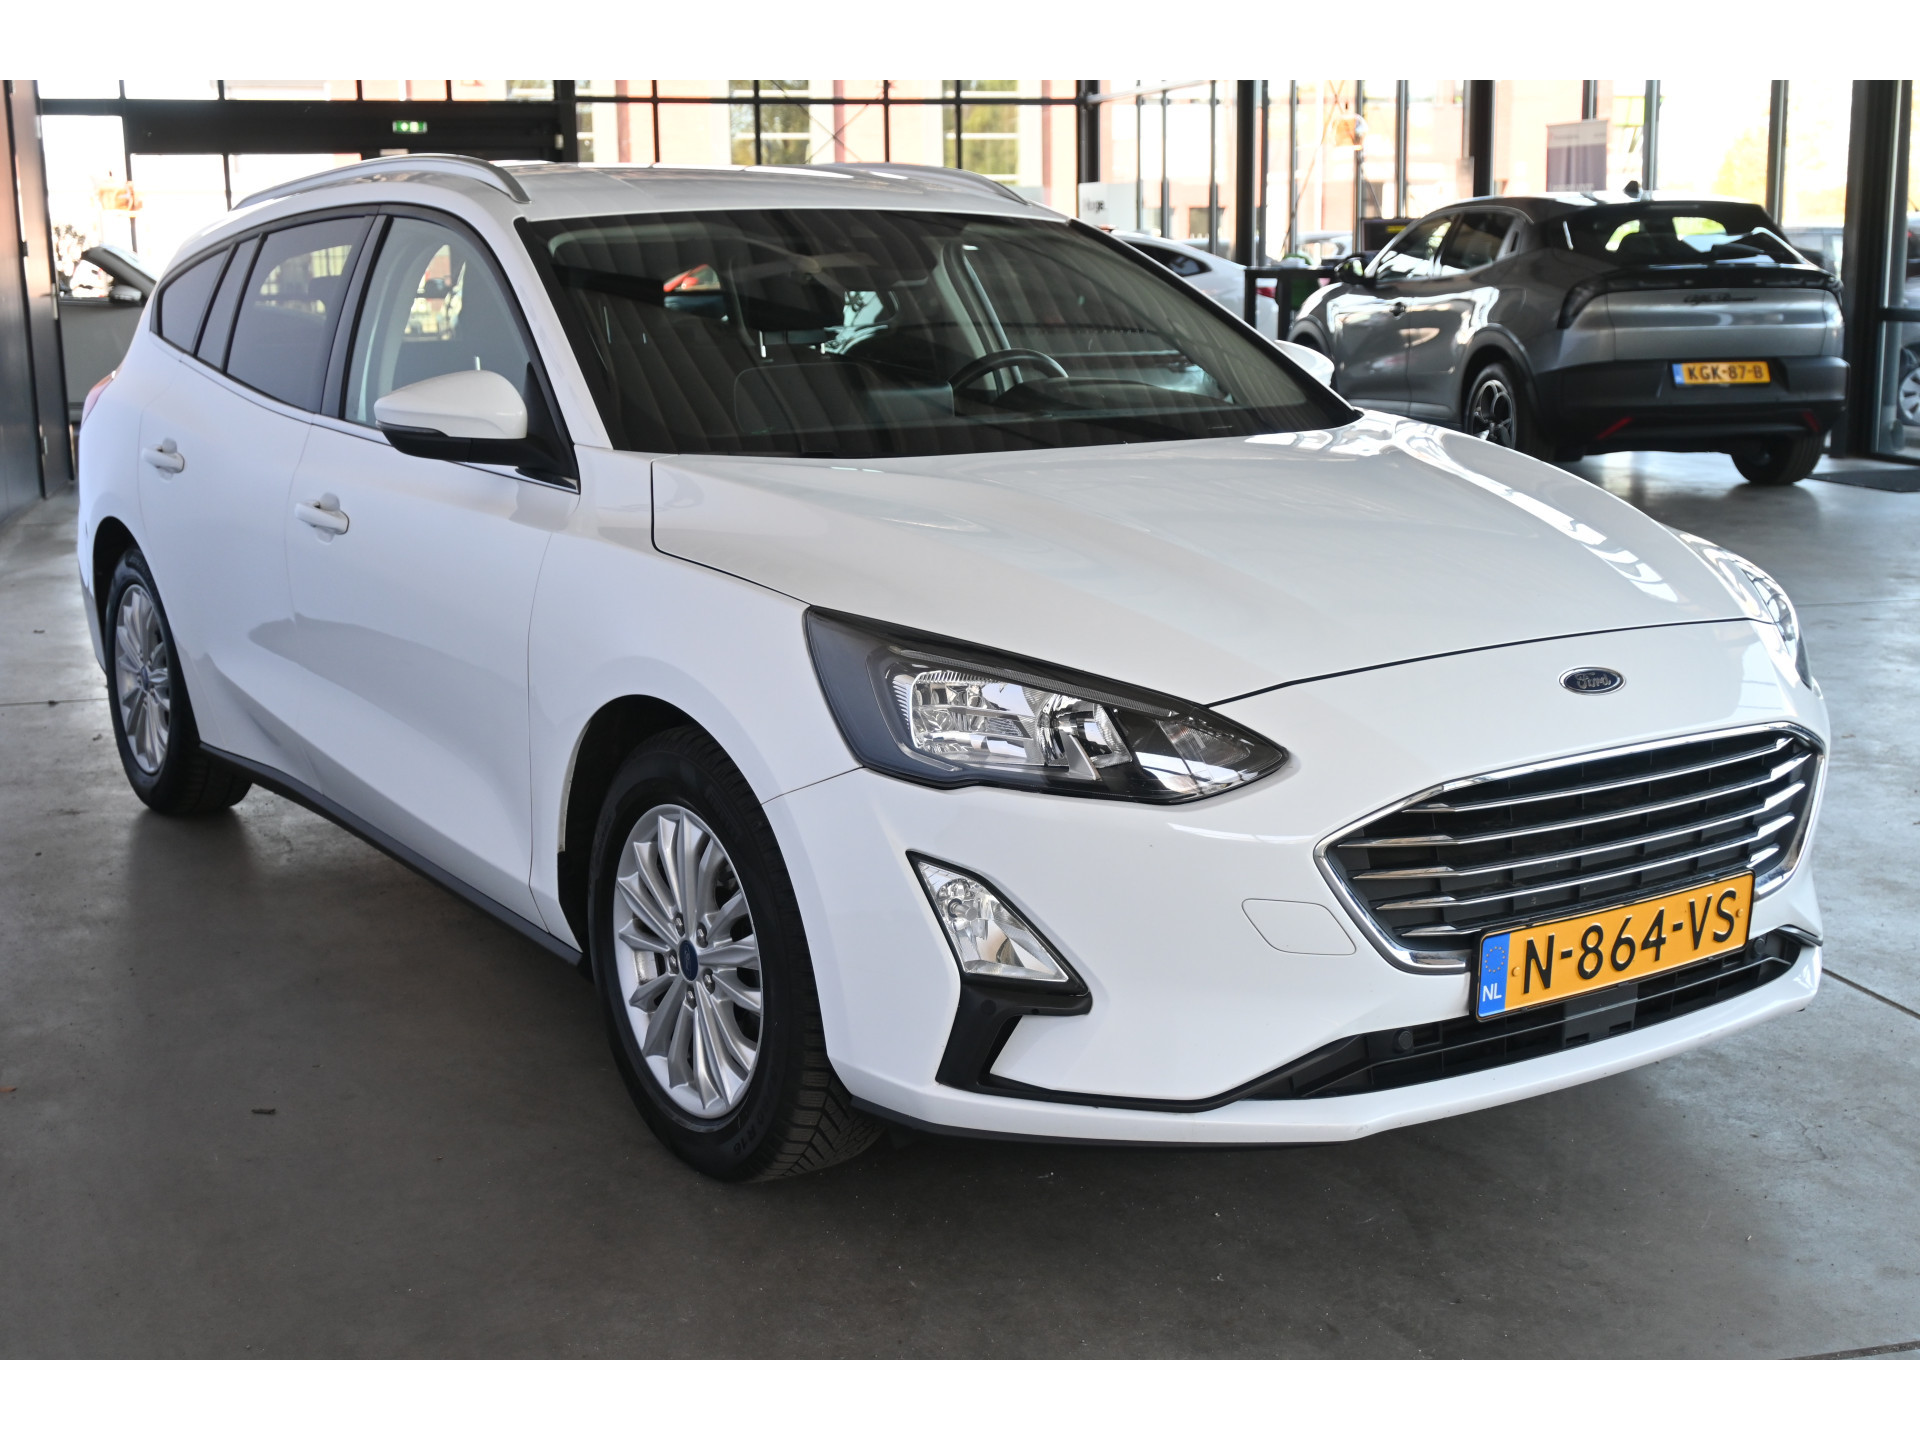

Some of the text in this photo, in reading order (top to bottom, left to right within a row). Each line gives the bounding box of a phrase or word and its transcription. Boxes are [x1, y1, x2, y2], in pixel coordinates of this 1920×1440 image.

[1687, 365, 1764, 381] KGK-87-B
[1575, 672, 1612, 690] Ford
[1523, 890, 1737, 994] N-864-VS
[1482, 982, 1502, 1002] NL
